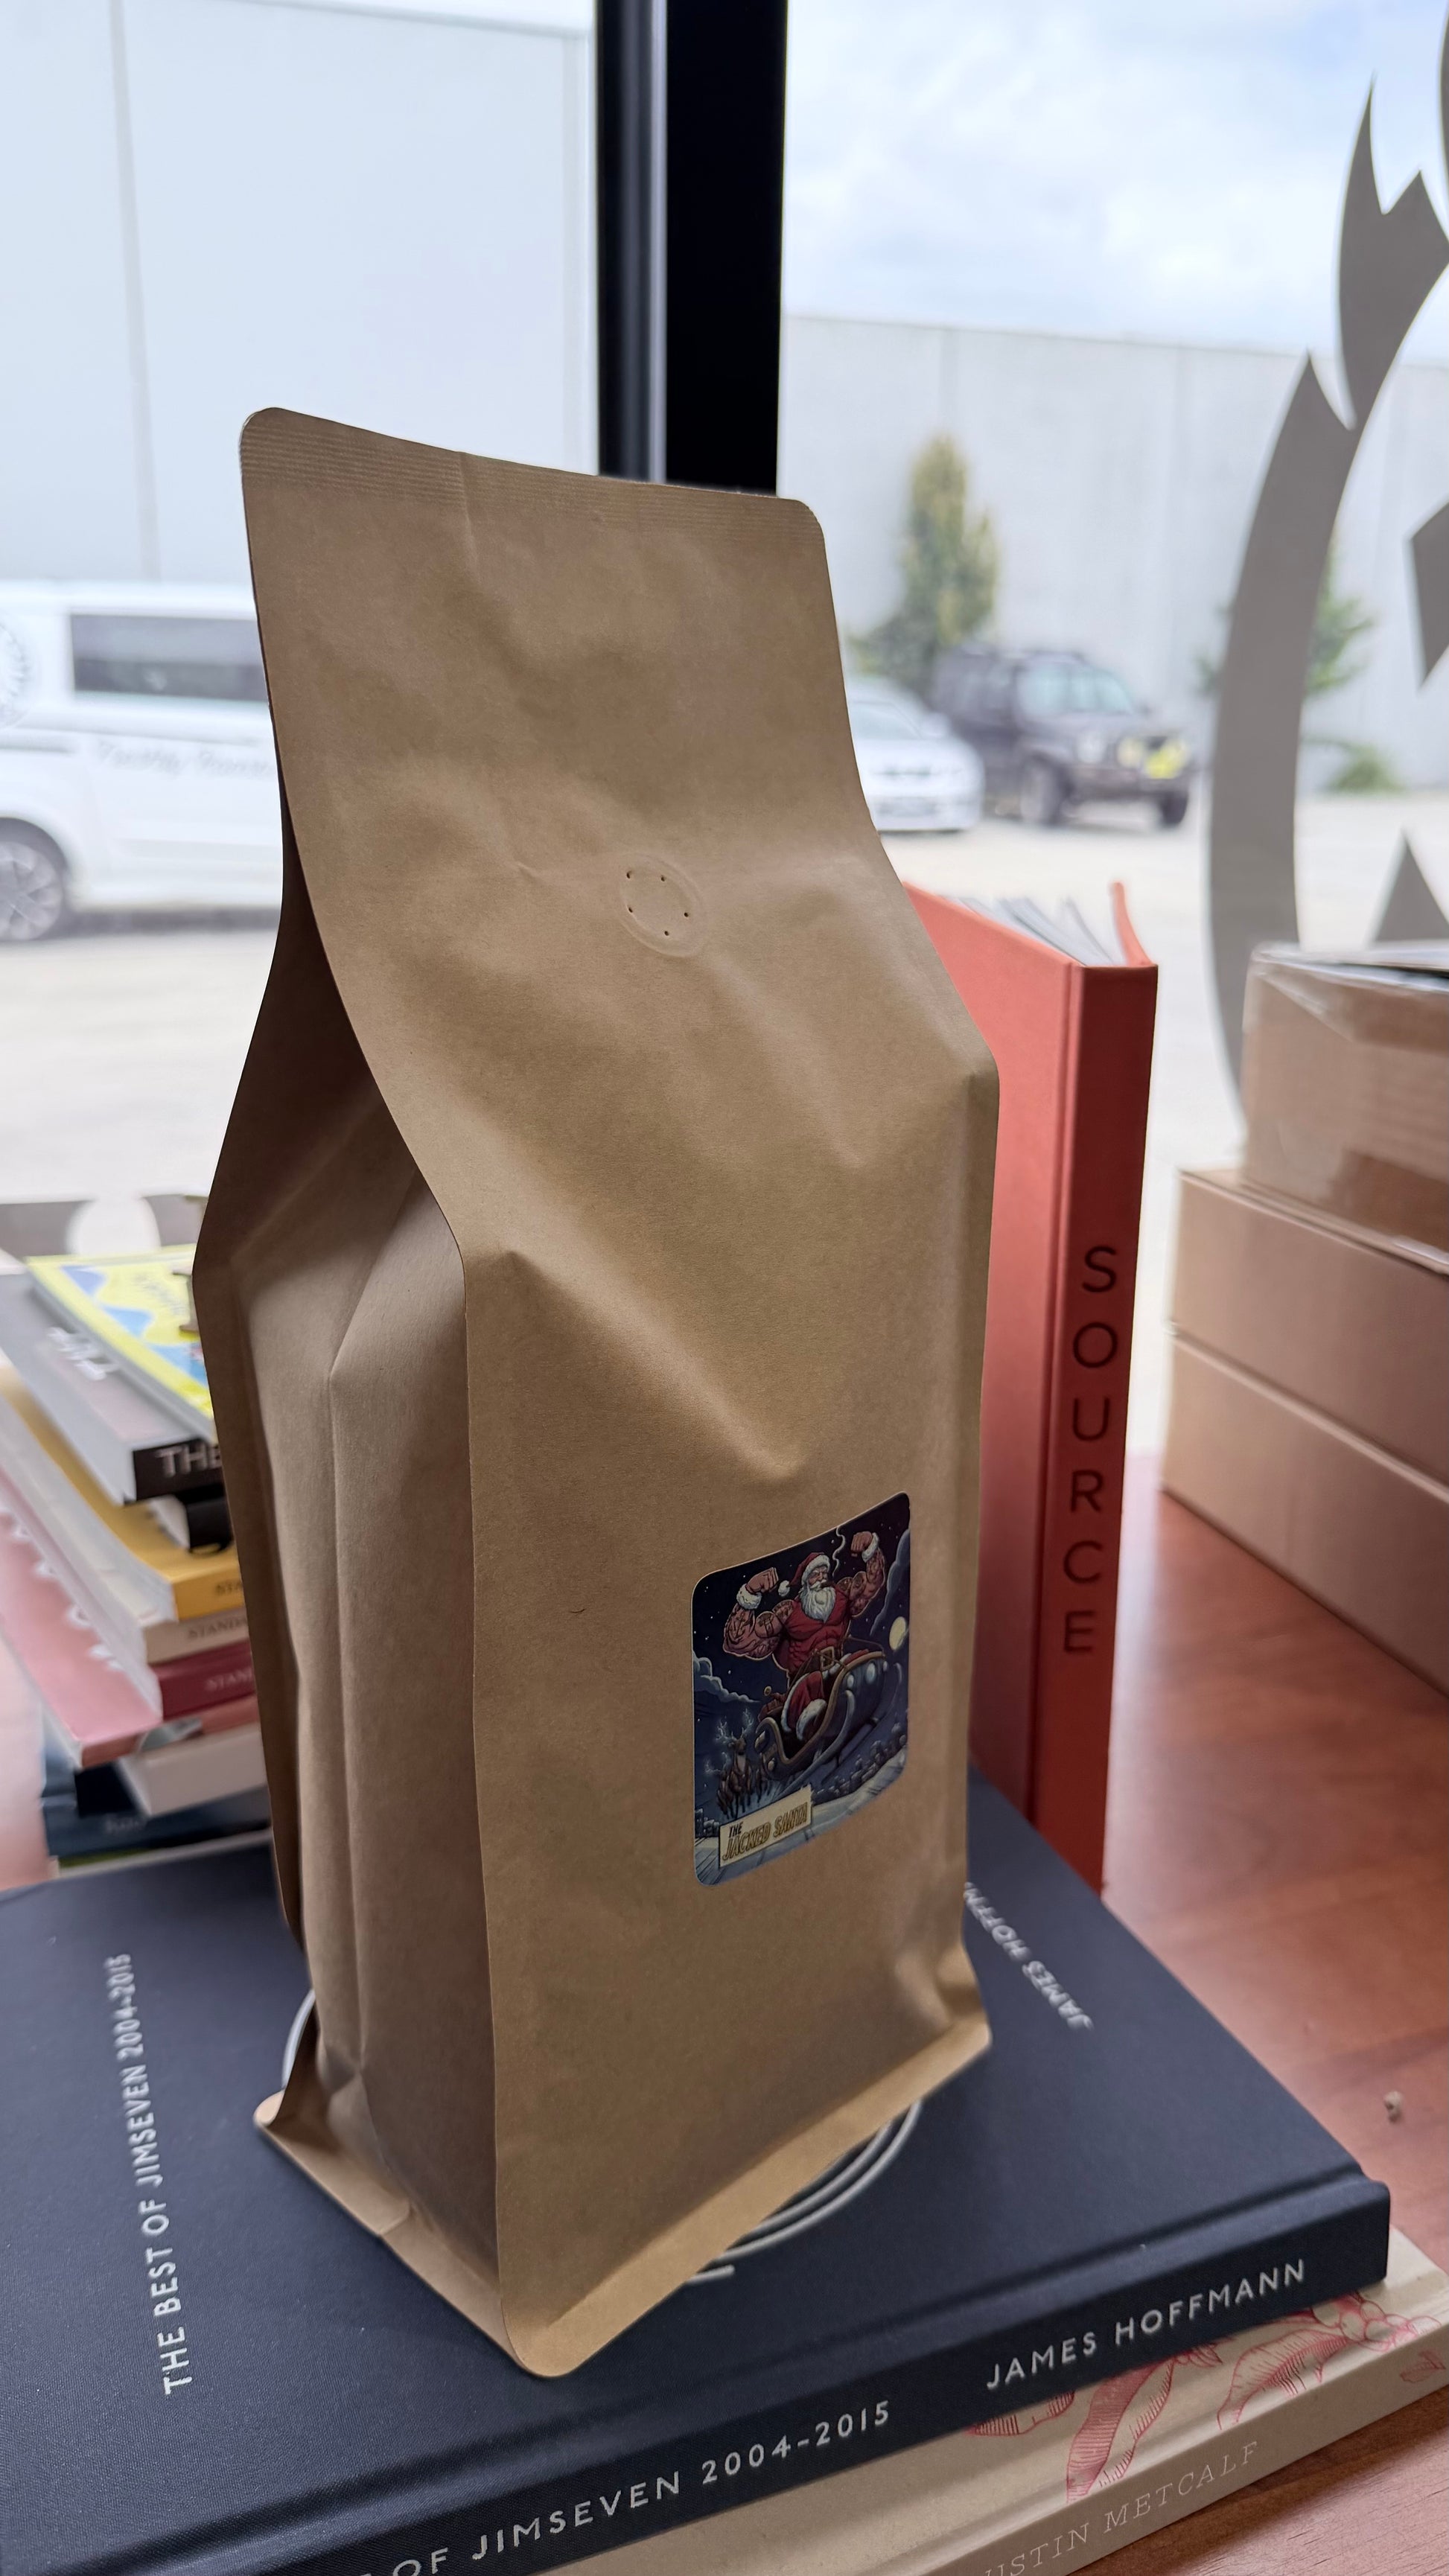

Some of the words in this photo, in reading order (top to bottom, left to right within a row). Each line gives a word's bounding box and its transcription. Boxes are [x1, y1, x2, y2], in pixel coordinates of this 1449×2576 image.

[1063, 1246, 1118, 1654] SOURCE
[722, 1822, 771, 1861] JACKED
[773, 1802, 808, 1837] SANTA
[729, 1821, 743, 1837] THE
[963, 1881, 1032, 1963] HOFFM
[1022, 1960, 1093, 2030] JAMES
[121, 2064, 163, 2187] JIMSEVEN
[138, 2199, 171, 2237] OF
[145, 2246, 182, 2318] BEST
[157, 2326, 193, 2395] THE
[472, 2472, 680, 2560] JIMSEVEN
[701, 2401, 890, 2485] 2004-2015
[987, 2332, 1098, 2390] JAMES
[1115, 2260, 1305, 2346] HOFFMANN
[1103, 2441, 1258, 2534] METCALF
